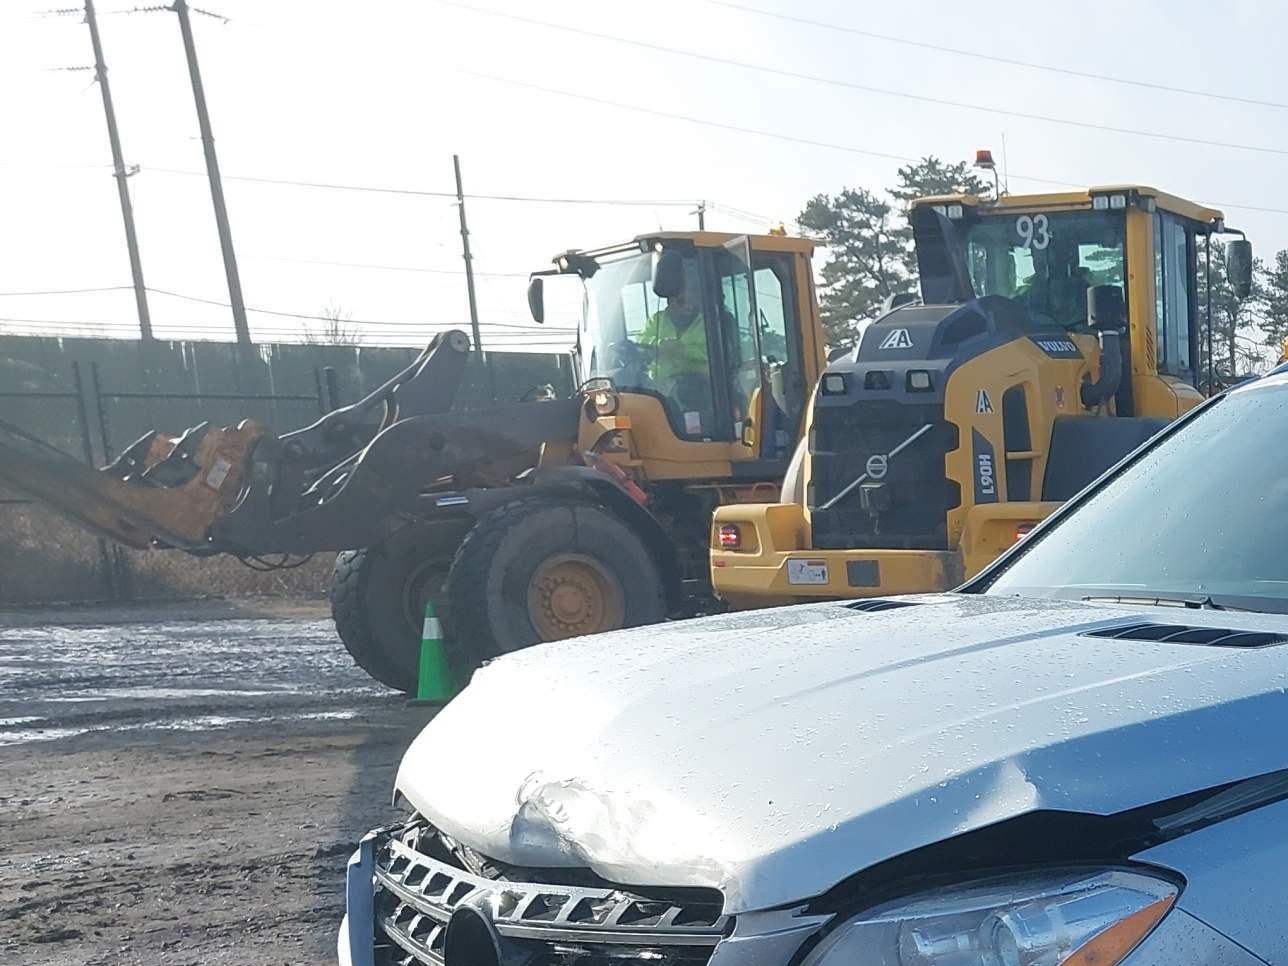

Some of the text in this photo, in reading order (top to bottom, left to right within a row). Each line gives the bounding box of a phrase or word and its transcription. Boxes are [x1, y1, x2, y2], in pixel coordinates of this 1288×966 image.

[1016, 214, 1049, 250] 93
[1038, 341, 1077, 352] VOLVO
[978, 454, 995, 494] L90H
